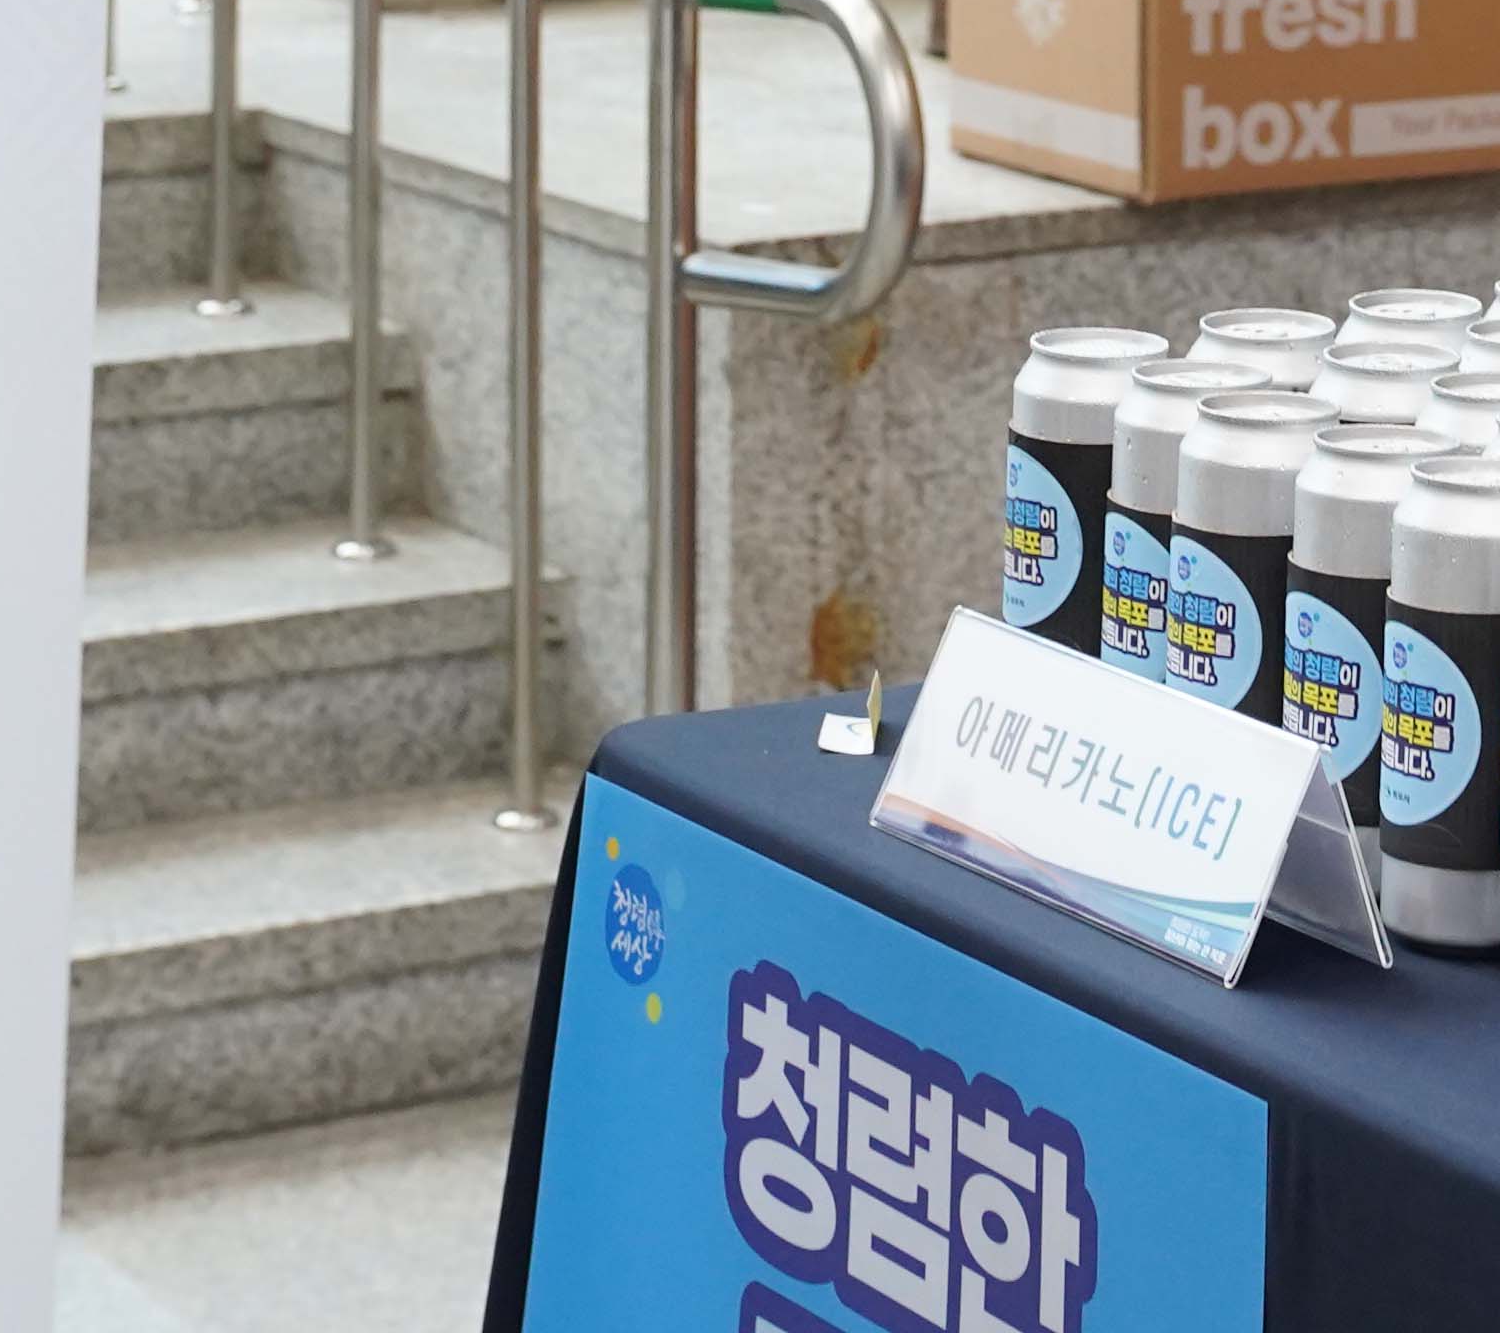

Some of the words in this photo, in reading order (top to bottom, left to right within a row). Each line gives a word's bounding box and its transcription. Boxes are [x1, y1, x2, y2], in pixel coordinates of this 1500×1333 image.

[1181, 84, 1342, 171] box
[955, 695, 1244, 862] 아메리카노(ICE)
[1380, 733, 1434, 781] 듭니다.
[736, 993, 1082, 1333] 청렴한
